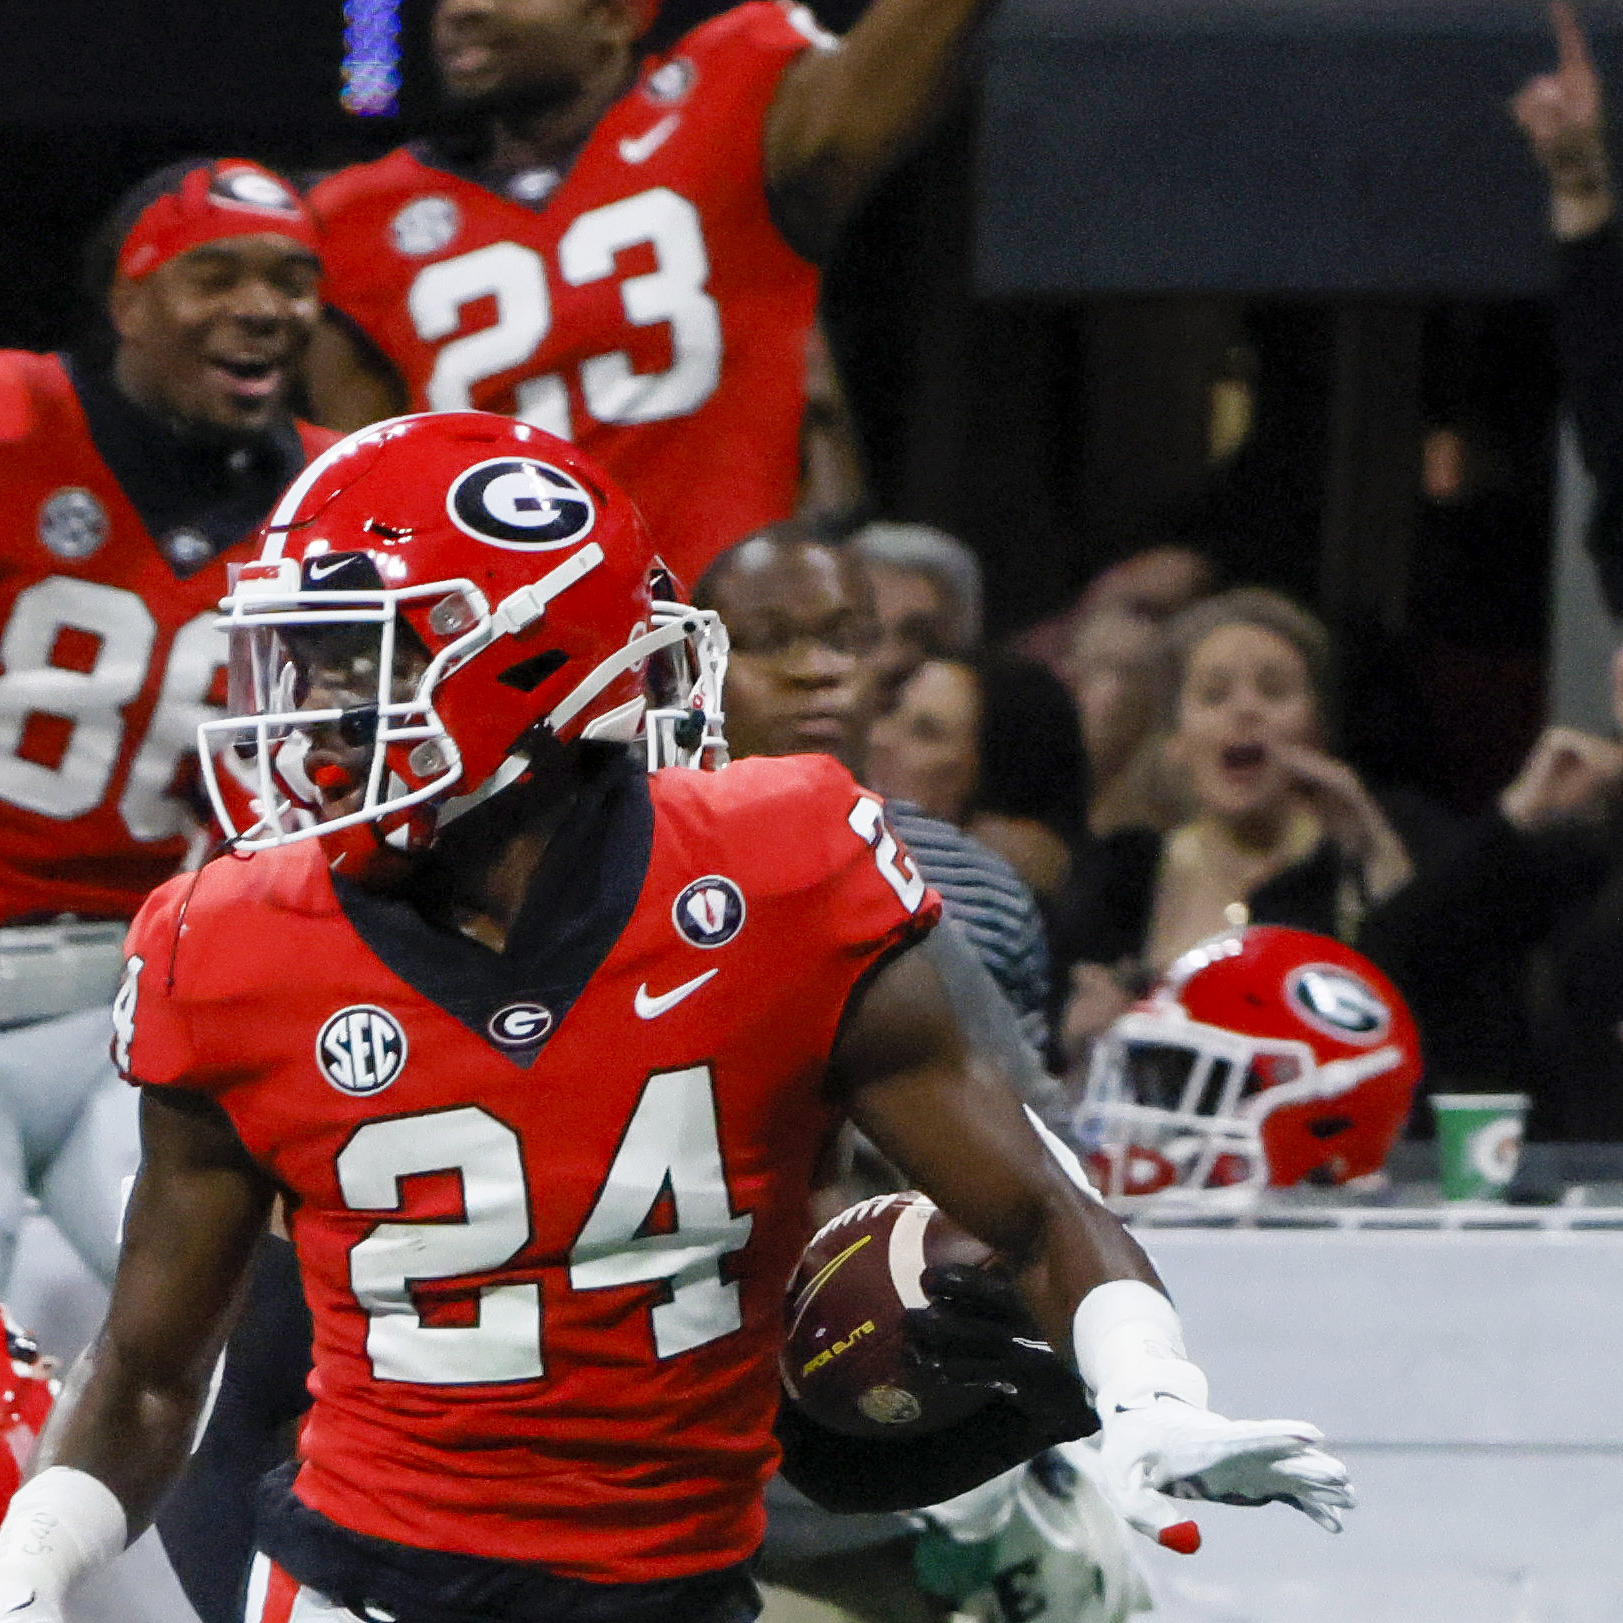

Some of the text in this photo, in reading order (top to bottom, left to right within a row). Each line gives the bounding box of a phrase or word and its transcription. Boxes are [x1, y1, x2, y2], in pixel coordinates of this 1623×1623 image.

[408, 187, 723, 440] 23
[451, 459, 592, 546] G
[320, 1011, 399, 1090] SEC
[493, 1005, 550, 1041] G
[335, 1063, 755, 1381] 24
